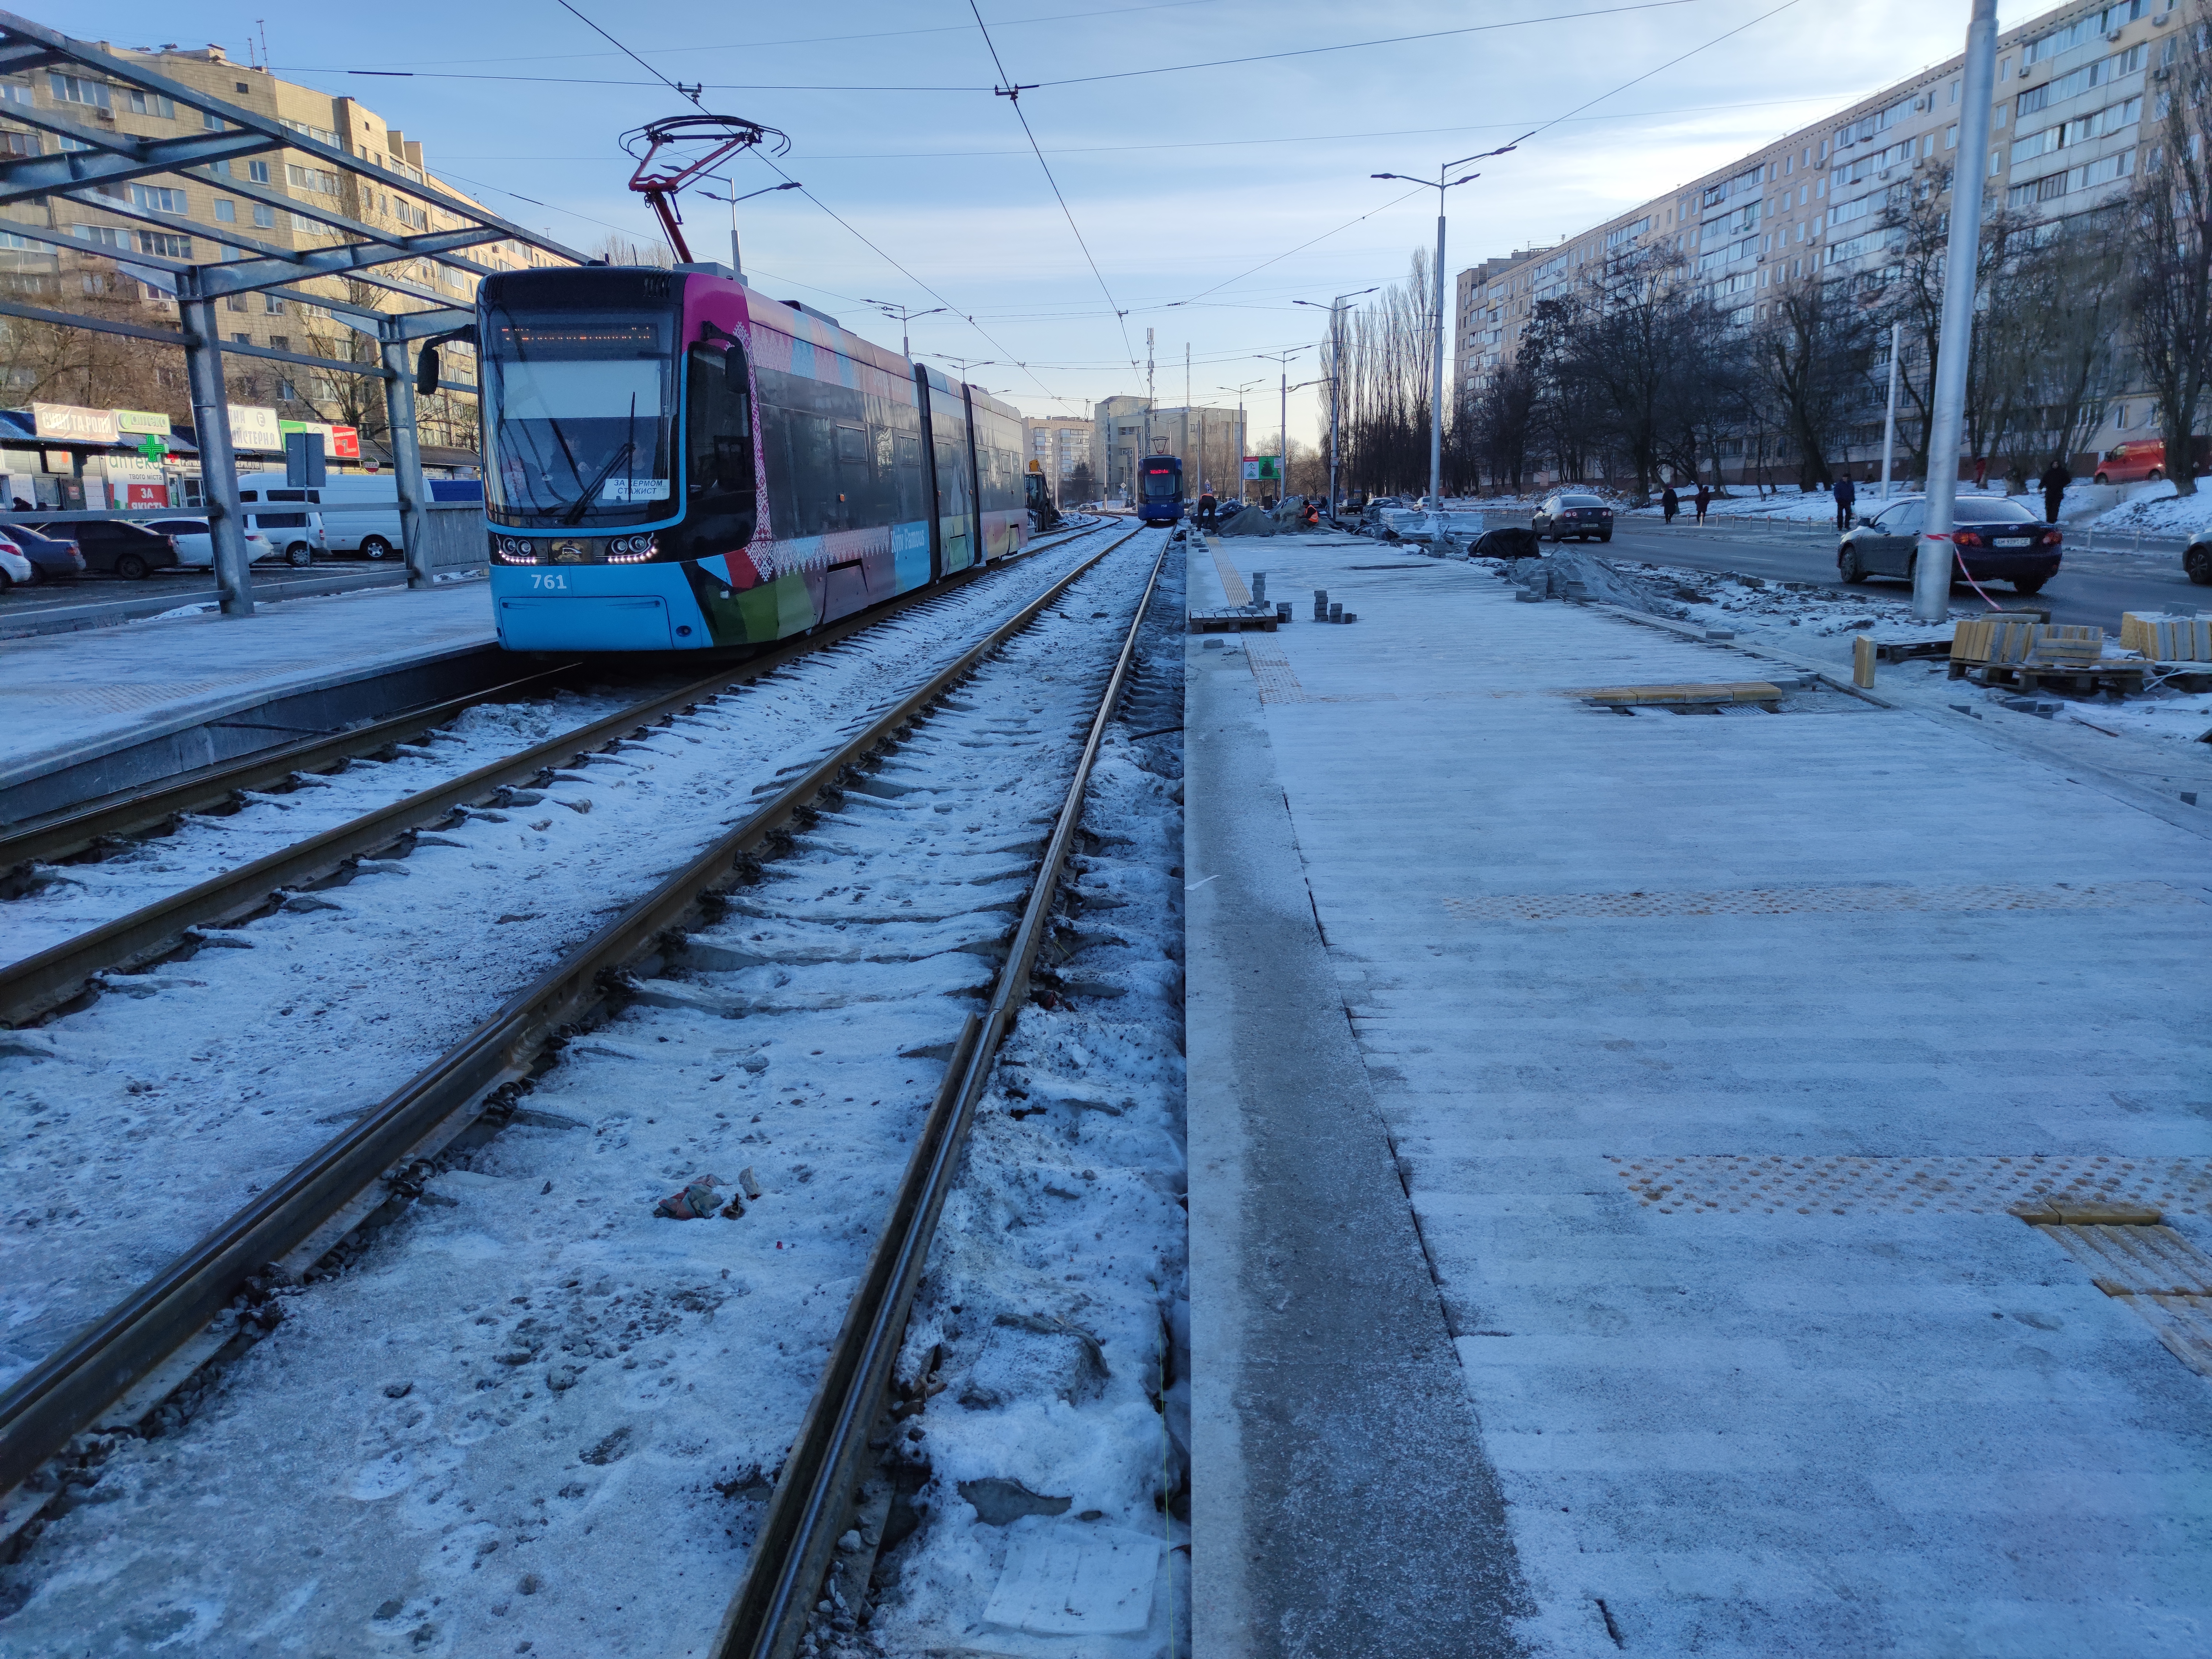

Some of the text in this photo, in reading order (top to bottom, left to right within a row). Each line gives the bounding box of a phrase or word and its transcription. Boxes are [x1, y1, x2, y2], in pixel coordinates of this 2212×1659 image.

[71, 414, 85, 432] ТА
[85, 416, 111, 434] РОЛИ
[130, 414, 168, 427] аптека
[228, 409, 245, 424] ТНА
[232, 427, 275, 445] АЙСТЕРНЯ
[140, 488, 154, 499] ЗА
[904, 528, 924, 550] Famous
[531, 574, 567, 589] 761
